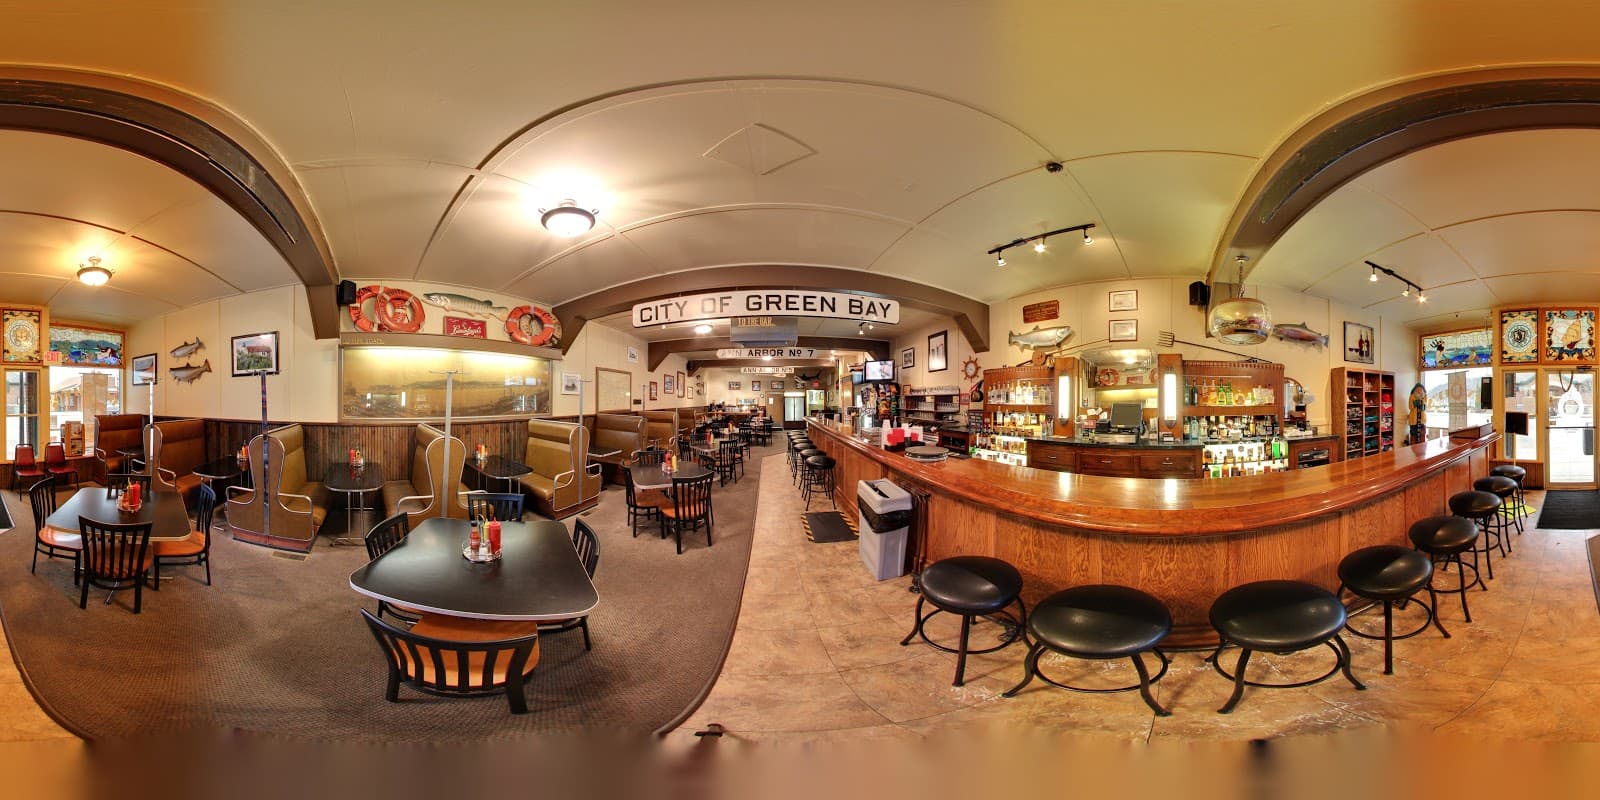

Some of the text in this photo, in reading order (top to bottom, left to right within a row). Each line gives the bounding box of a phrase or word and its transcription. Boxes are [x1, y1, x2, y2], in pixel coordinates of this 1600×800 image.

[640, 294, 891, 323] CITY OF GREEN BAY
[747, 349, 784, 357] ARBOR
[807, 349, 814, 358] 7
